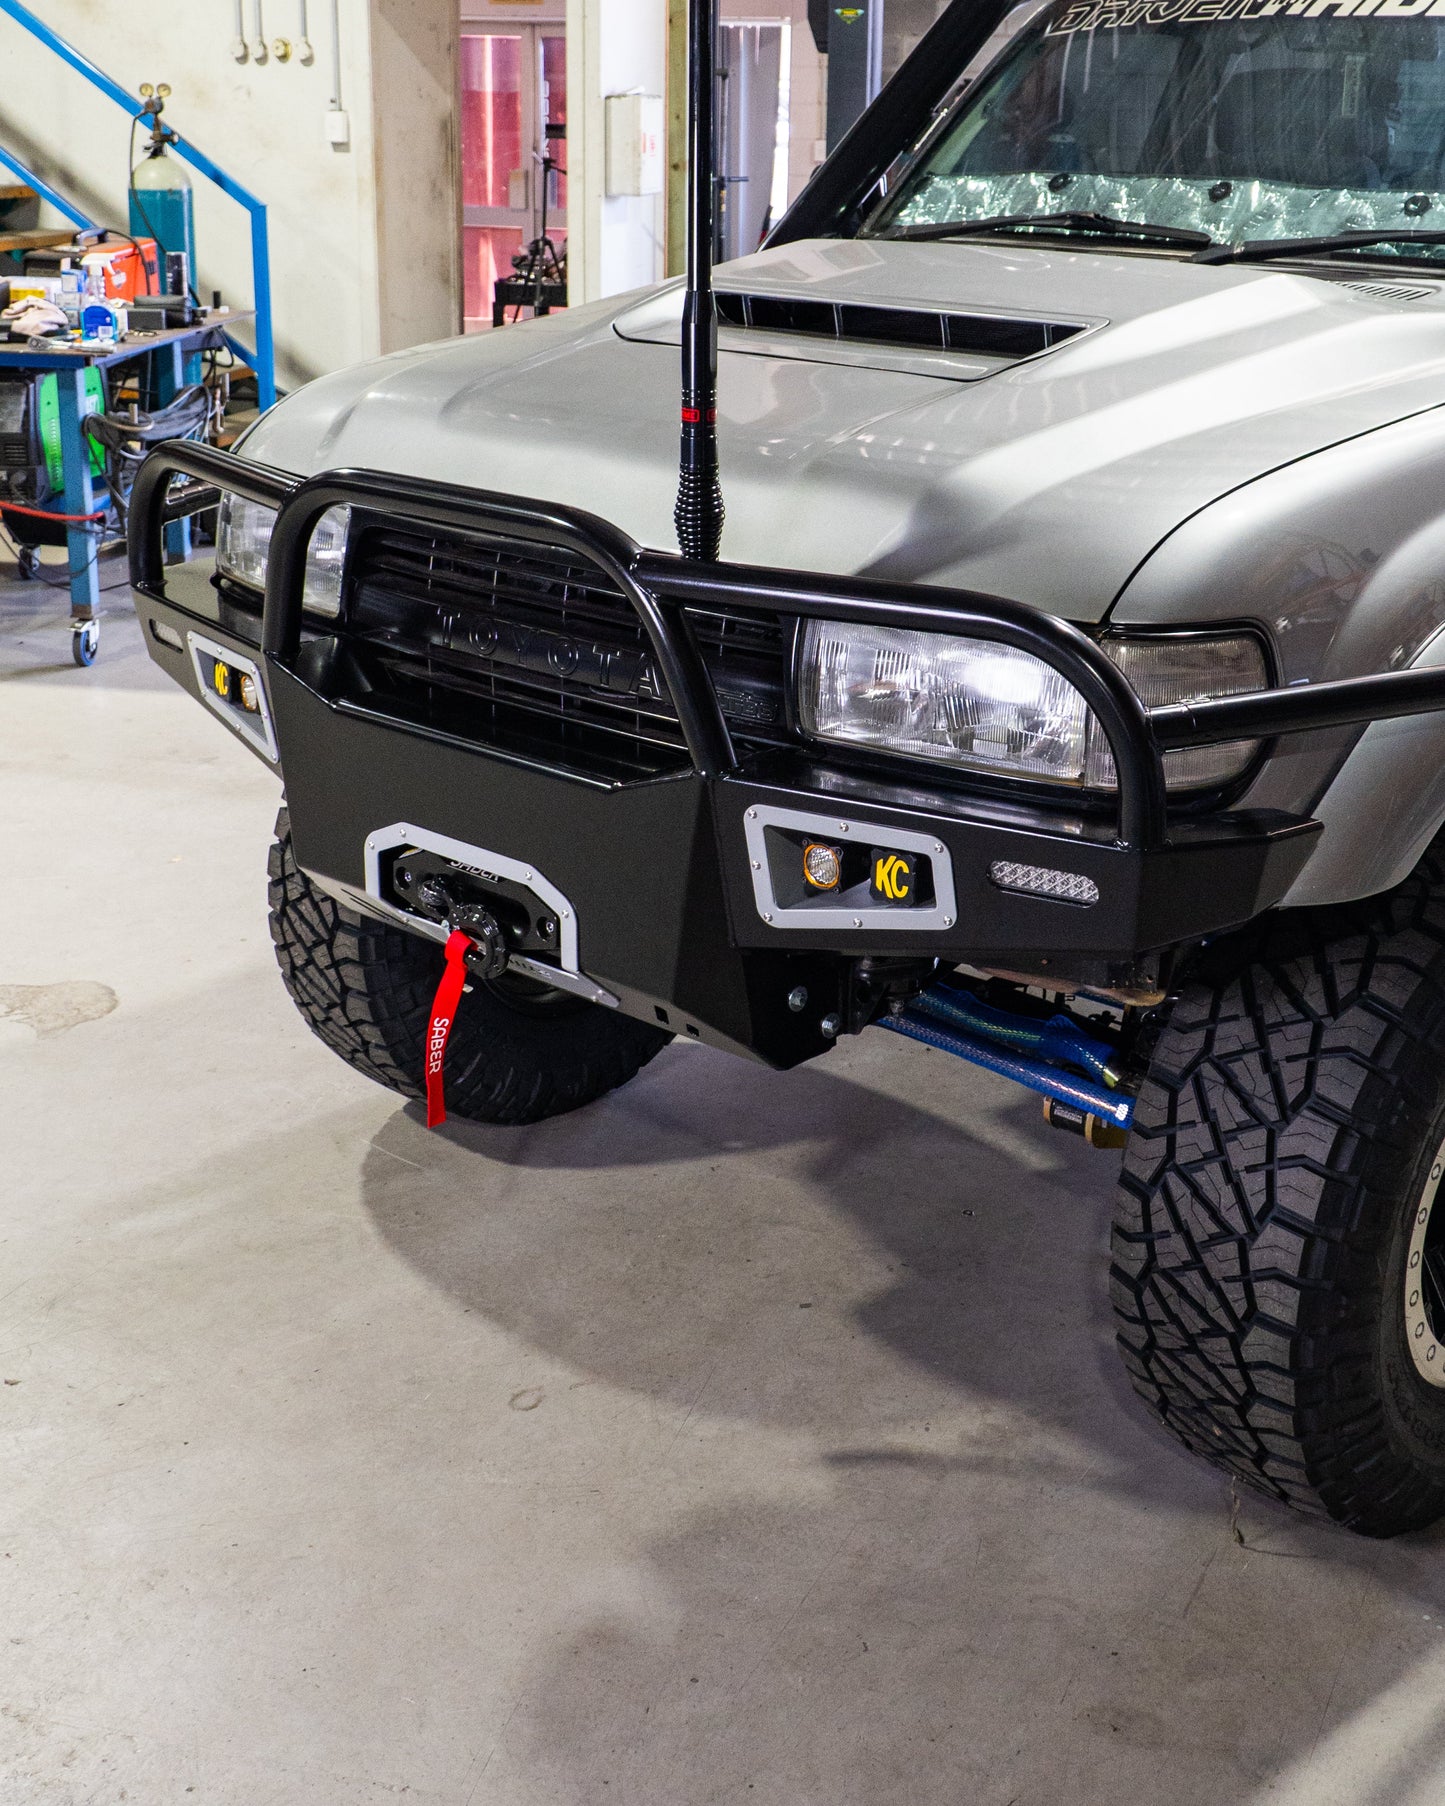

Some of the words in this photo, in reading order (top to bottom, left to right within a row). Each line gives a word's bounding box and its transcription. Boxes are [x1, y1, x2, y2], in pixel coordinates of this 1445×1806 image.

[215, 662, 228, 695] KC
[436, 605, 663, 701] TOYOTA
[876, 855, 910, 899] KC
[429, 1017, 450, 1075] SABER
